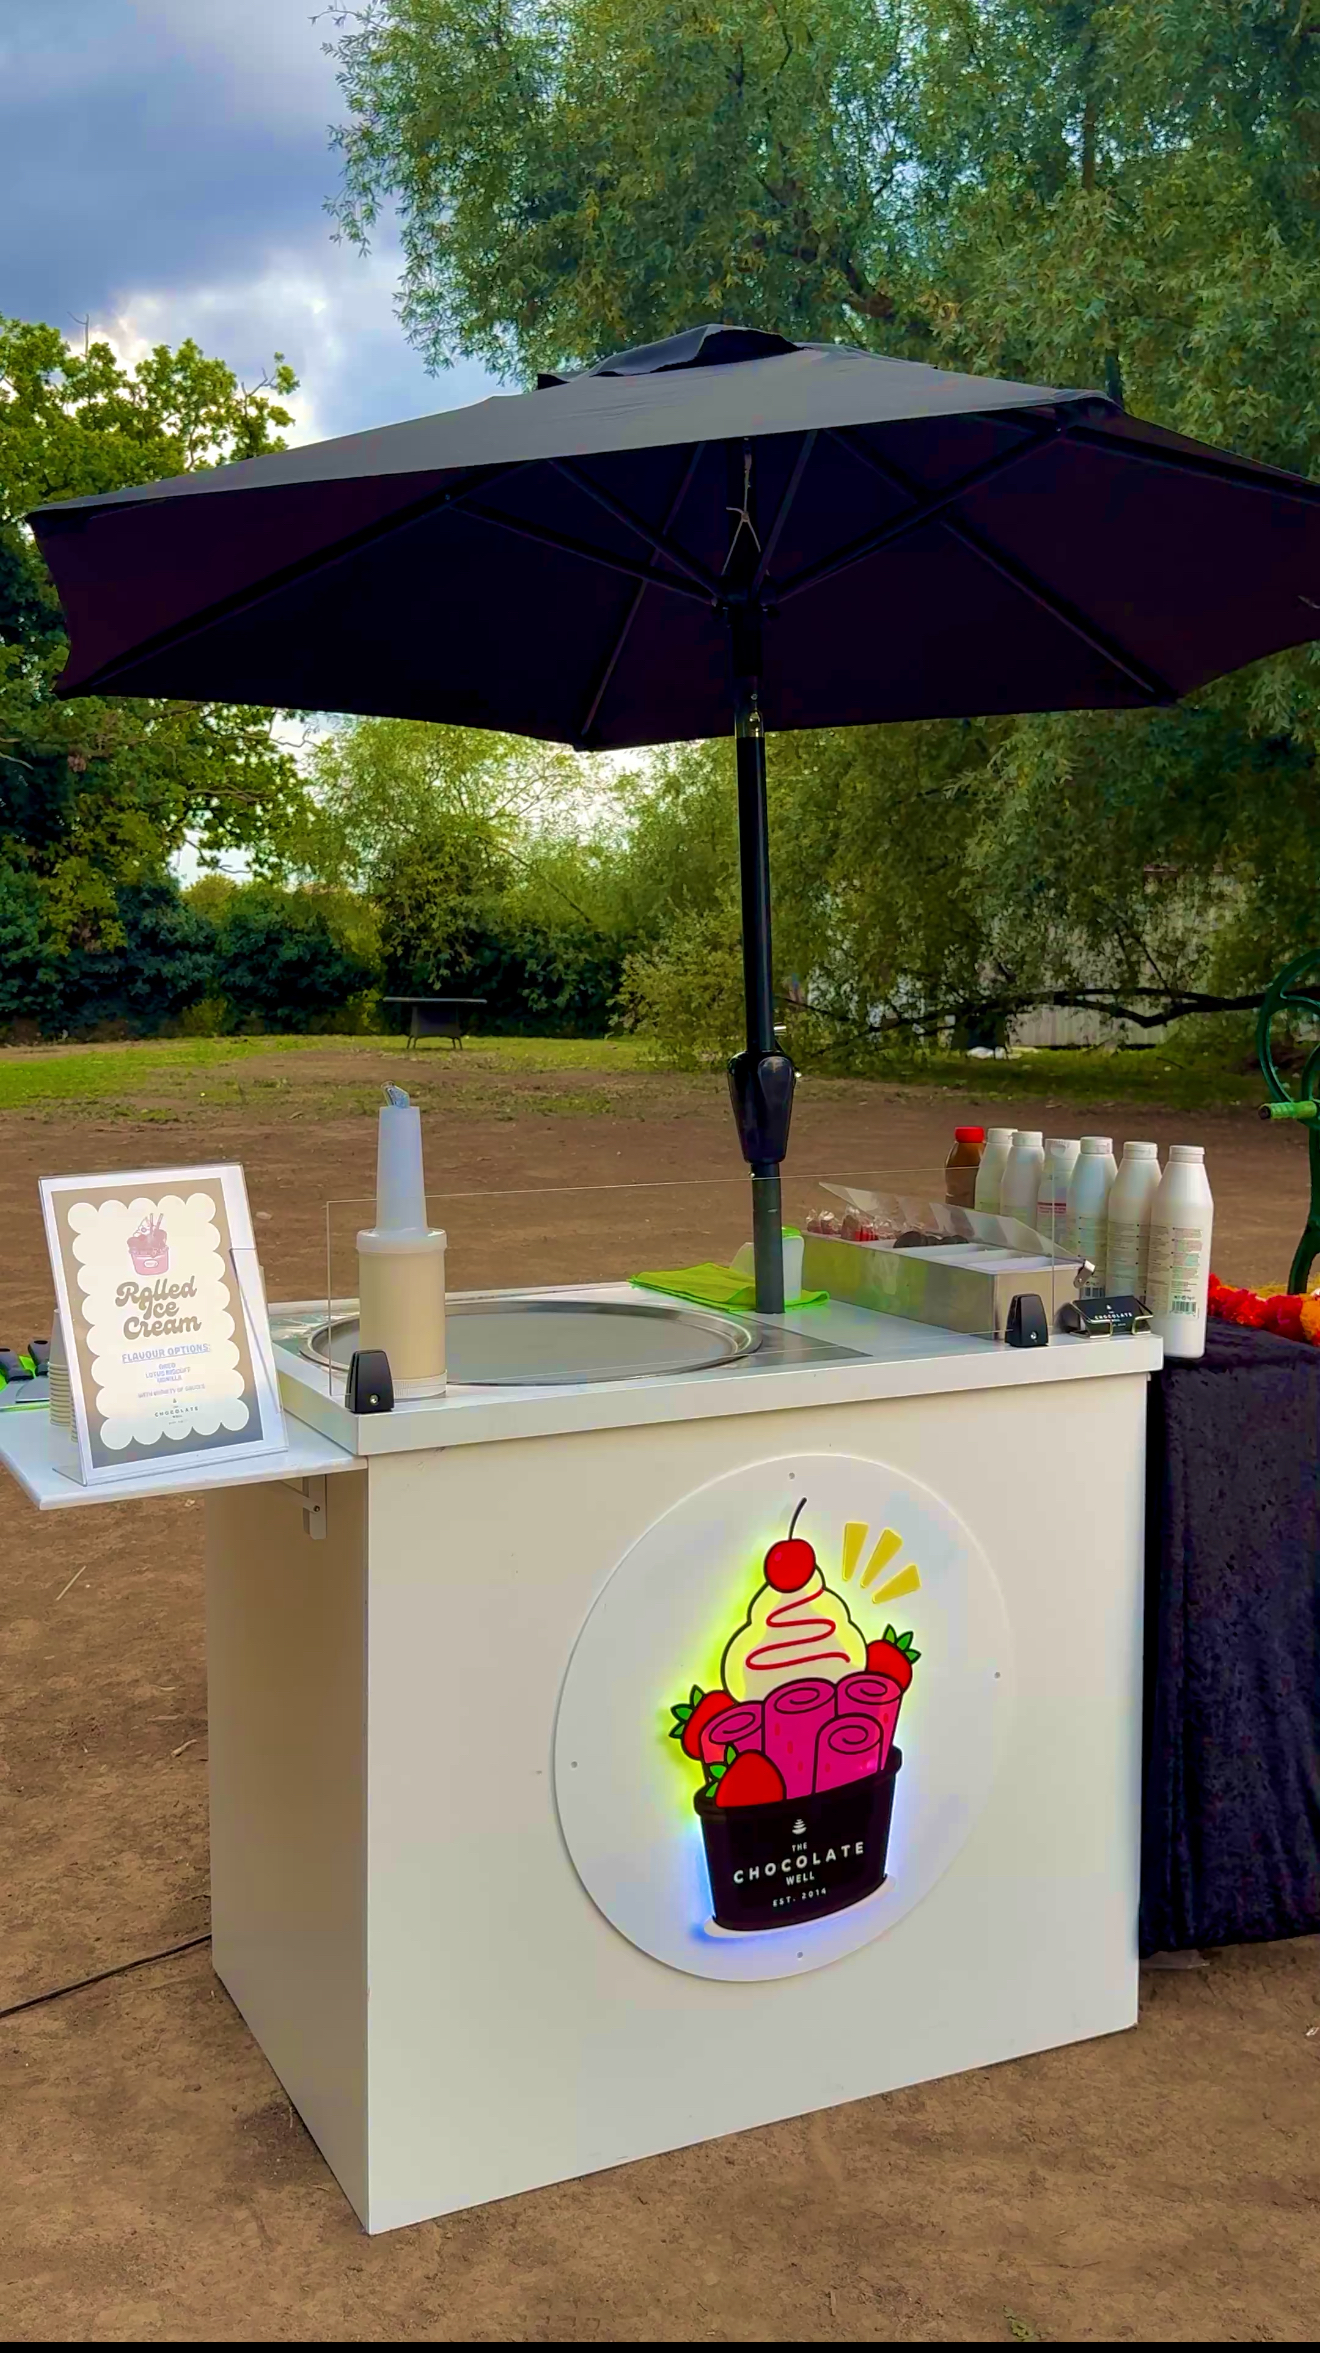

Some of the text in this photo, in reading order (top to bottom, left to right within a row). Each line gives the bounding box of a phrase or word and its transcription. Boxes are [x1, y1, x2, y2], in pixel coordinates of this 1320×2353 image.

[115, 1275, 197, 1307] Rolled
[139, 1301, 179, 1320] Ice
[123, 1316, 202, 1340] Cream
[122, 1343, 211, 1363] FLAVOUR OPTIONS:
[154, 1406, 199, 1418] CHOCOLATE
[791, 1842, 808, 1852] THE
[733, 1841, 864, 1884] CHOCOLATE
[786, 1871, 815, 1886] WELL
[772, 1887, 827, 1907] EST. 2014
